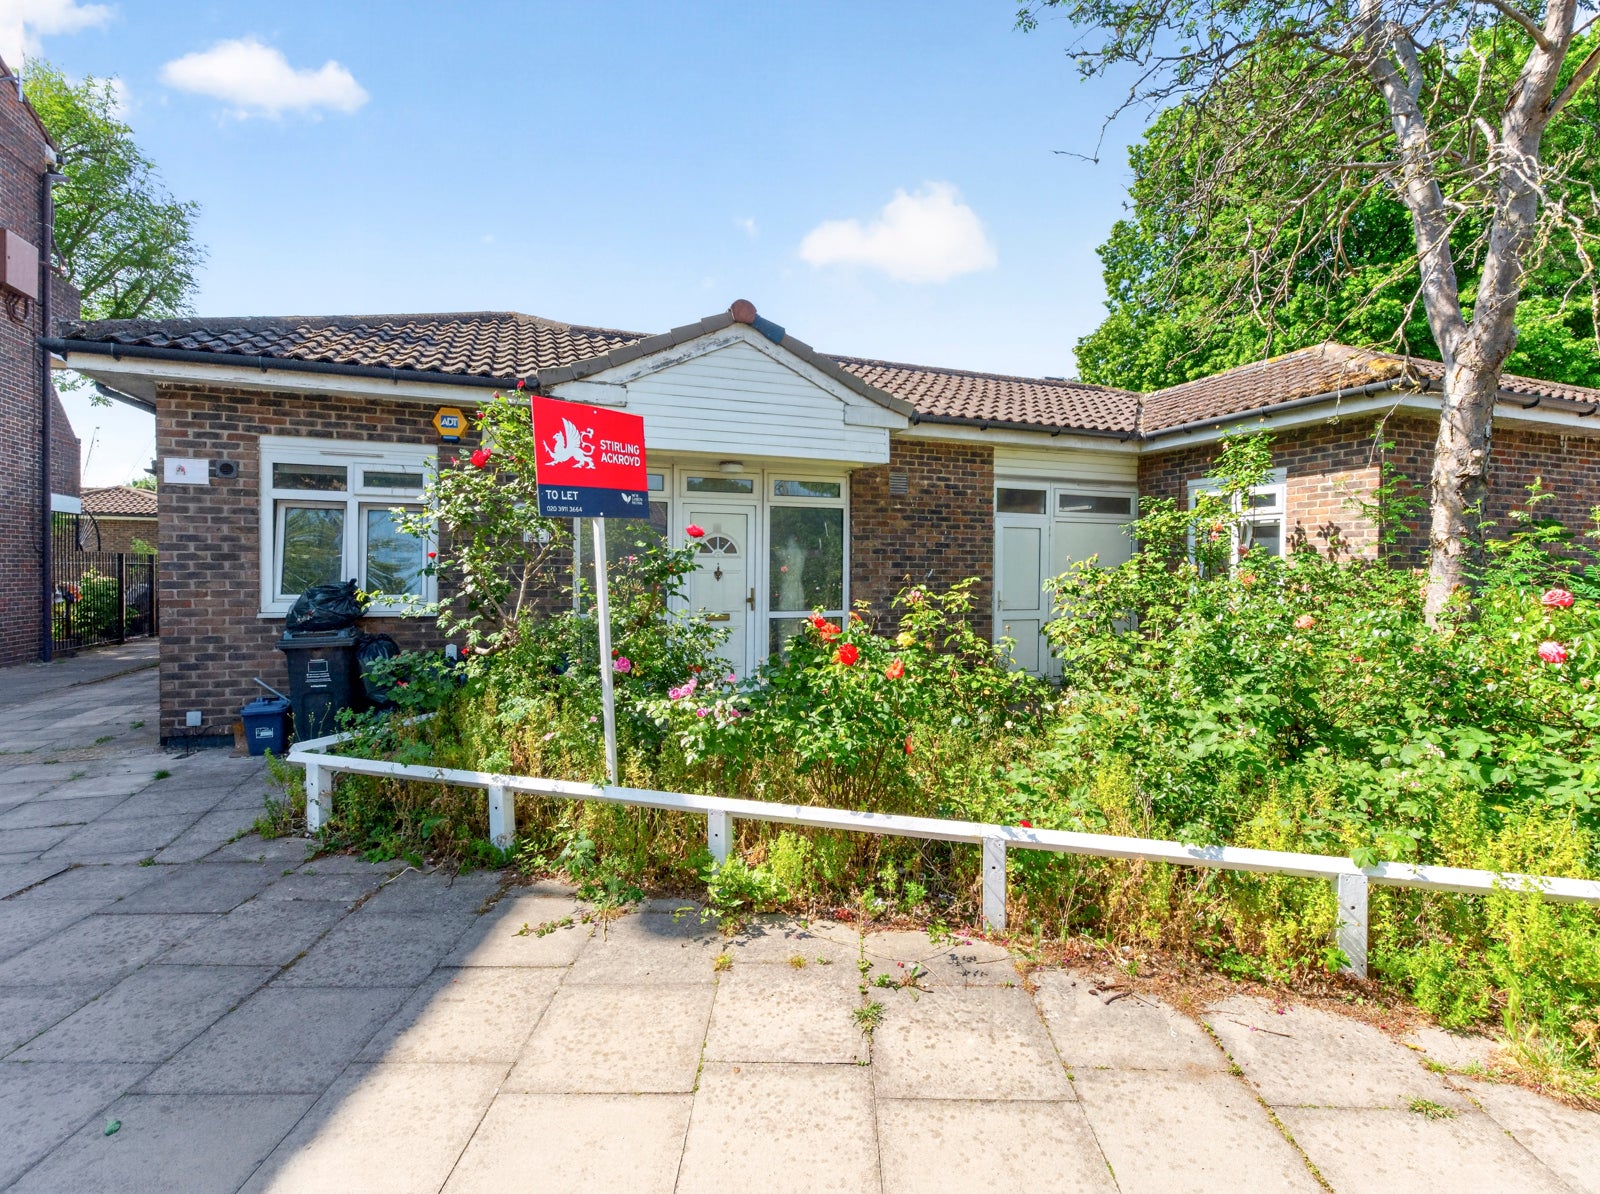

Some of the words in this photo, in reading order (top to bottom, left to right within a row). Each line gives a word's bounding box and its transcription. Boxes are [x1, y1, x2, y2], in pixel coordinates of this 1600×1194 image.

[440, 417, 458, 426] ADT
[600, 440, 640, 455] STIRLING
[601, 453, 641, 467] ACKROYD
[545, 490, 559, 500] TO
[561, 490, 578, 501] LET
